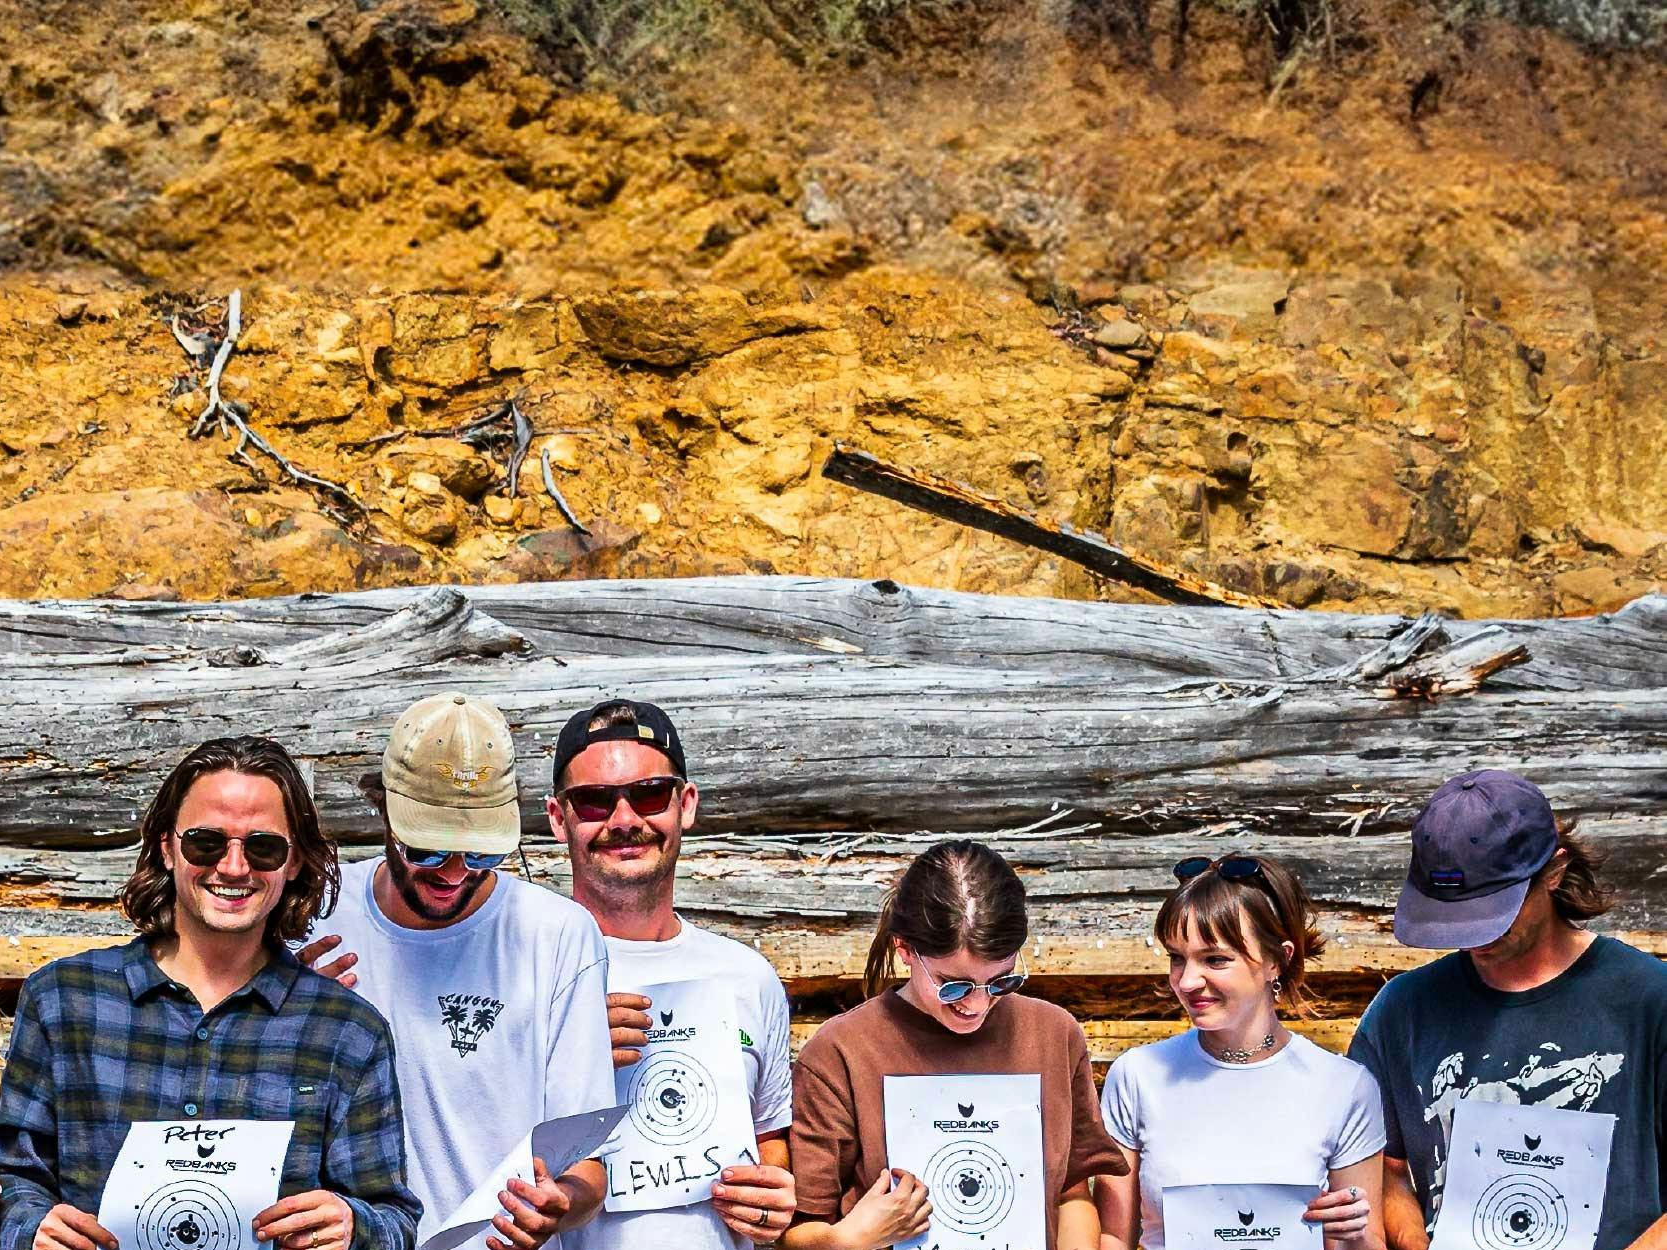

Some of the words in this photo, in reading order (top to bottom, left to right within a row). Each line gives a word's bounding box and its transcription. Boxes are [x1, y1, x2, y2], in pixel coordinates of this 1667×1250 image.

[445, 993, 500, 1009] CANGGU
[643, 1027, 696, 1039] EDBANKS
[933, 1120, 1000, 1131] REDBANKS
[163, 1124, 236, 1143] Peter
[1496, 1149, 1564, 1166] REDBANKS
[165, 1159, 237, 1173] REDBANKS
[607, 1146, 722, 1198] LEWIS
[1214, 1227, 1281, 1238] REDBANKS
